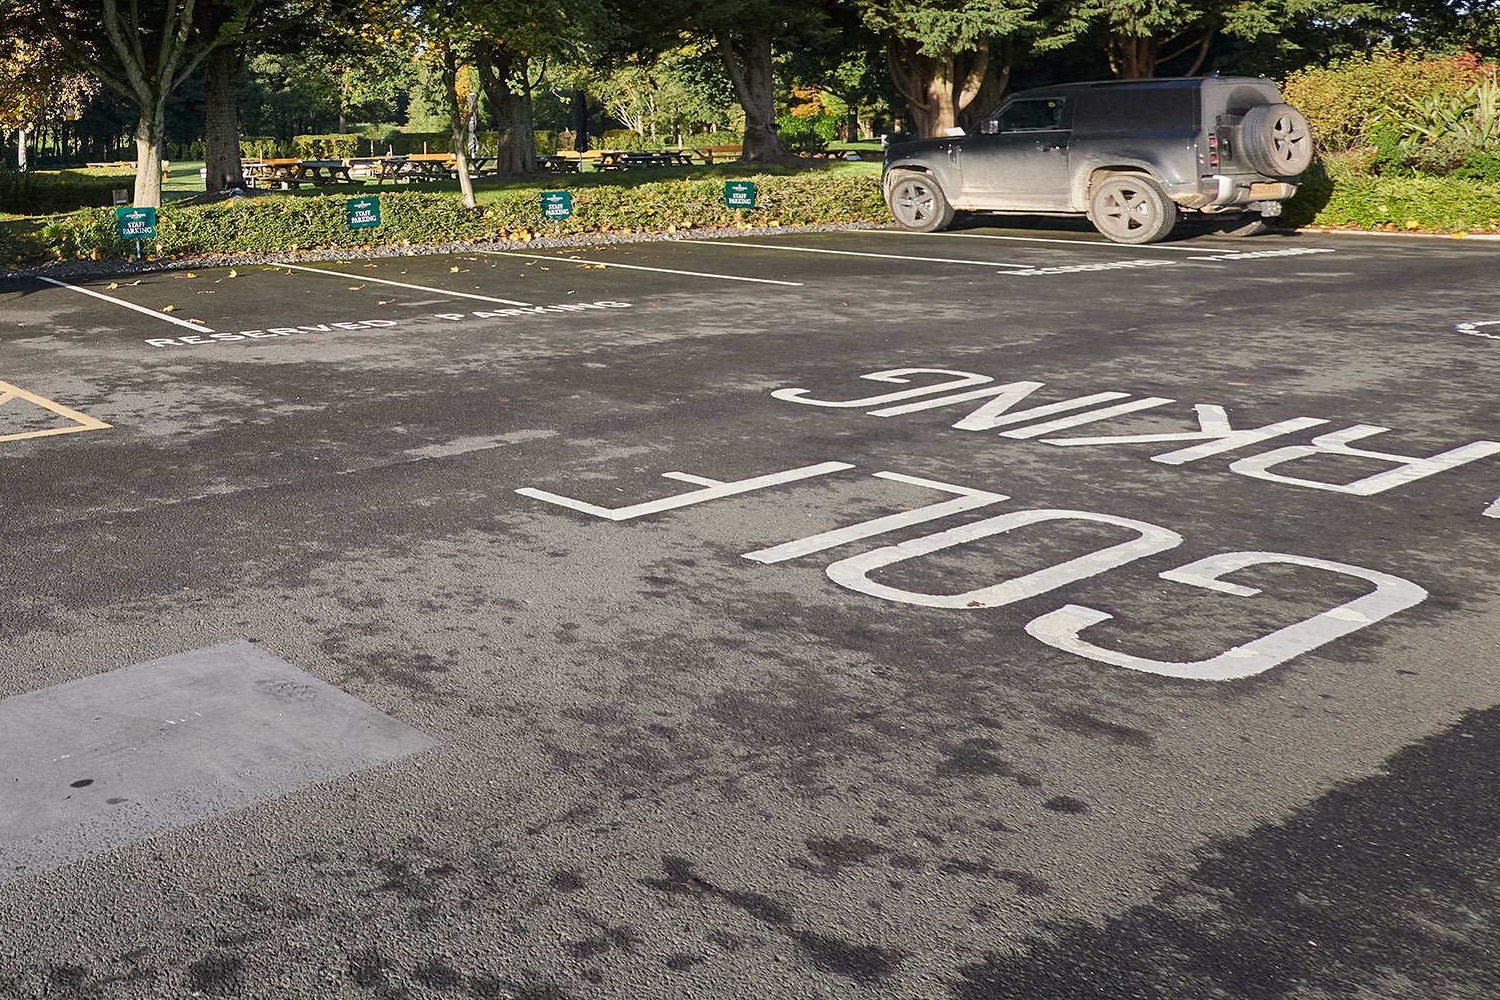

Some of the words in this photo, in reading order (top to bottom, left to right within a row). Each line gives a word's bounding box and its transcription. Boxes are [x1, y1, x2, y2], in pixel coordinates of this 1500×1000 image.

[351, 215, 377, 223] PARKING
[145, 319, 397, 347] RESERVED
[435, 301, 633, 321] PARKING
[515, 462, 1428, 681] GOLF
